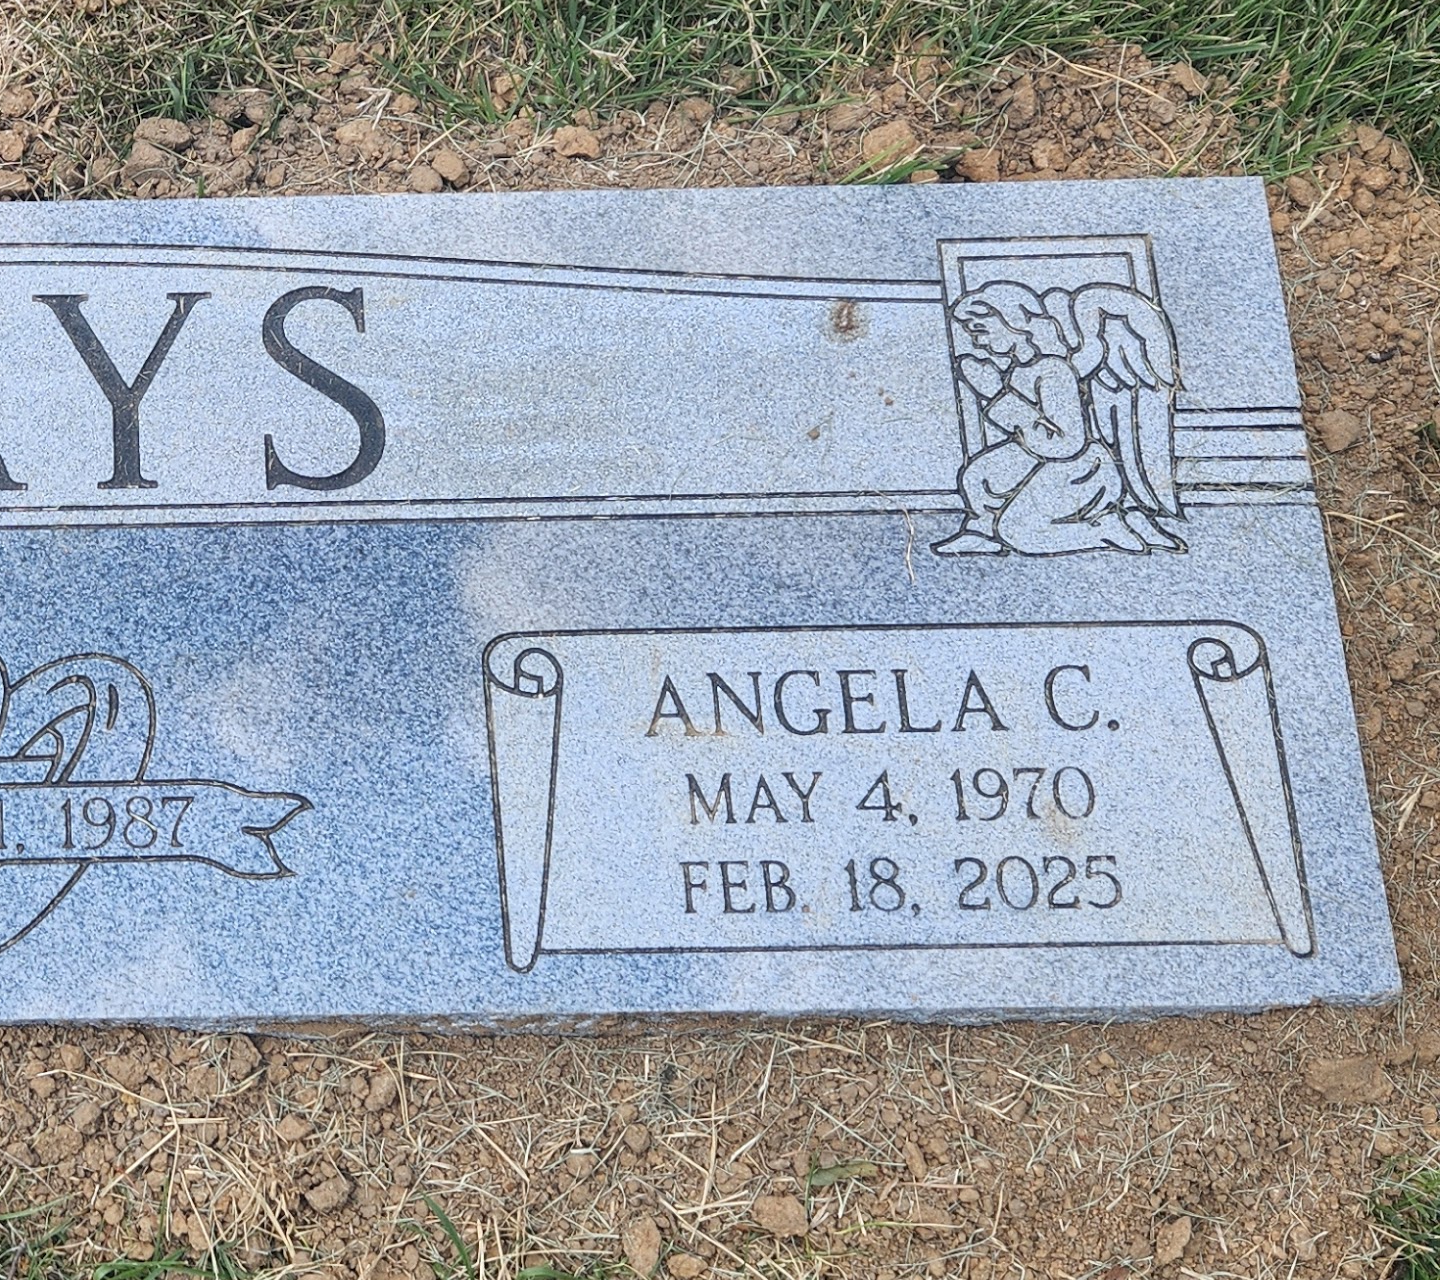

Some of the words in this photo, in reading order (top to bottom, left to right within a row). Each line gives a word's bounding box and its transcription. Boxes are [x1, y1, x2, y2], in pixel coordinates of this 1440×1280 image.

[644, 668, 1010, 737] ANGELA
[1043, 664, 1120, 732] C.
[60, 795, 194, 850] 1987
[685, 771, 823, 825] MAY
[856, 769, 919, 827] 4,
[949, 766, 1096, 821] 1970
[680, 860, 811, 915] FEB.
[844, 857, 920, 917] 18,
[954, 855, 1123, 910] 2025
